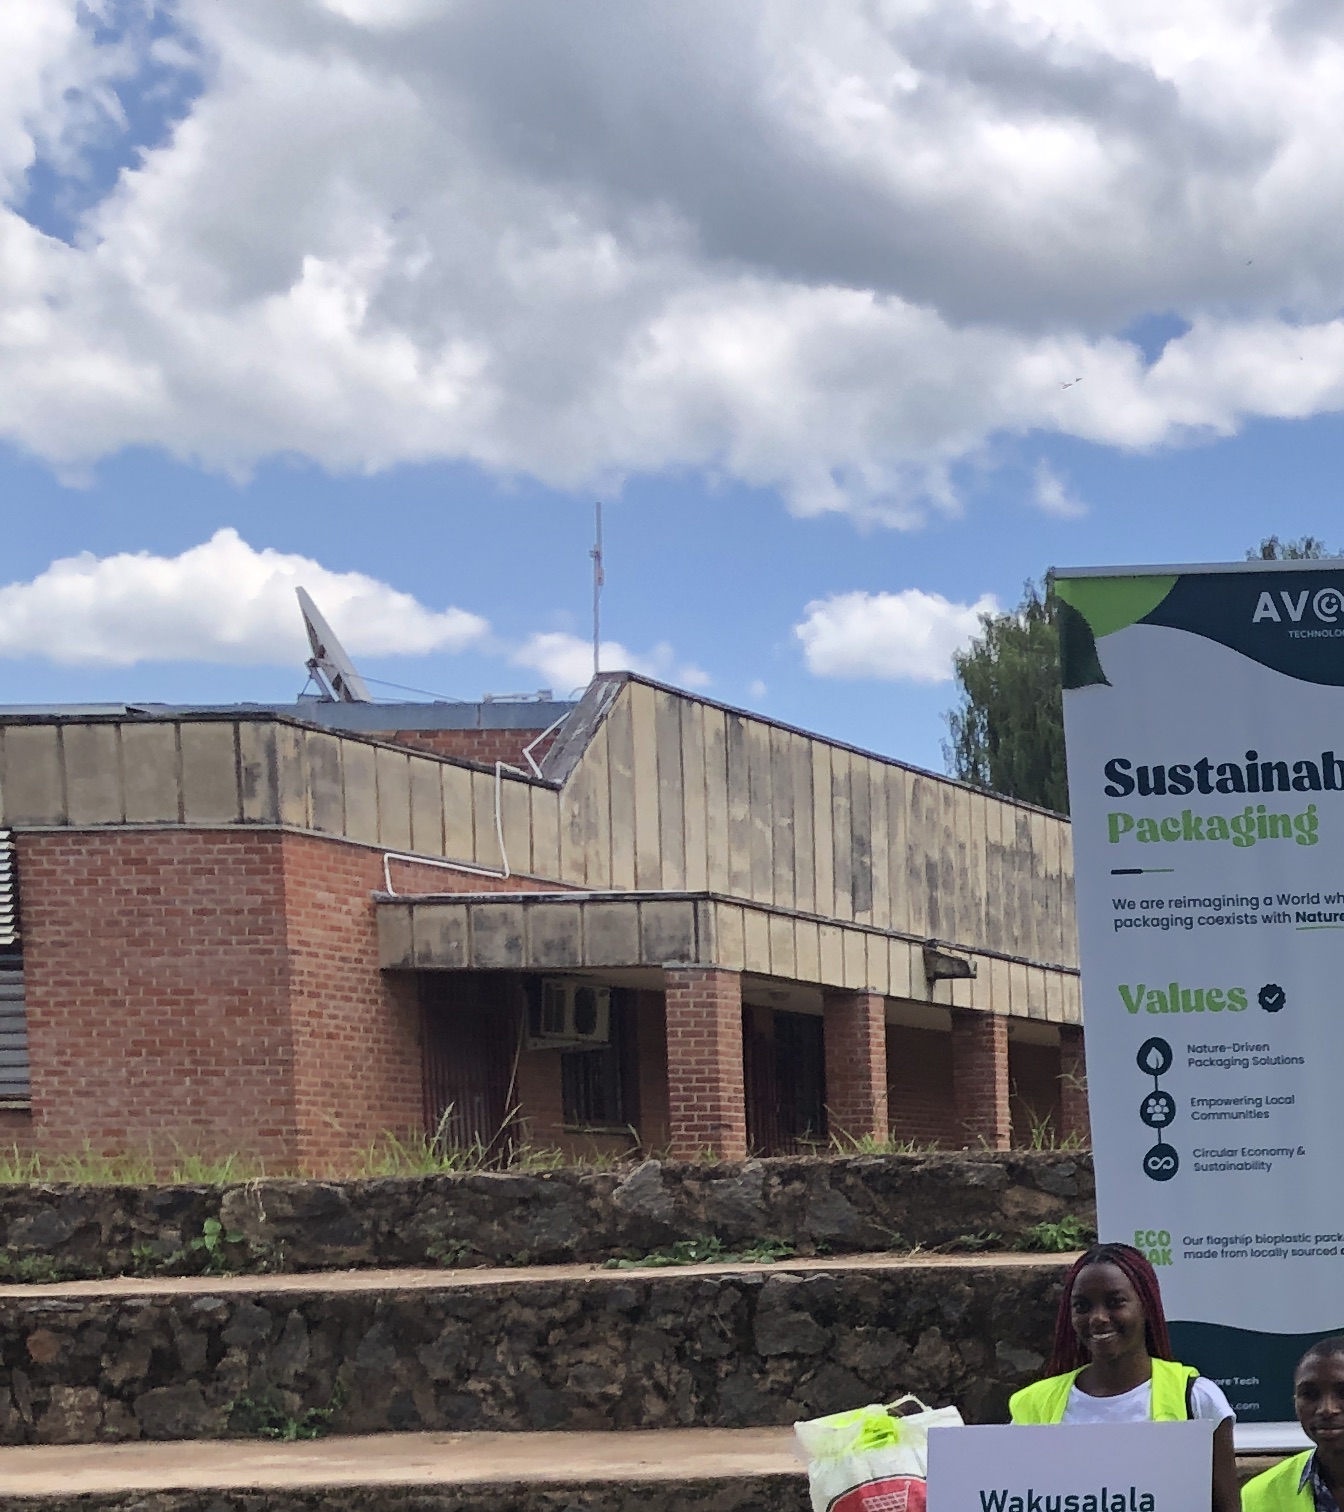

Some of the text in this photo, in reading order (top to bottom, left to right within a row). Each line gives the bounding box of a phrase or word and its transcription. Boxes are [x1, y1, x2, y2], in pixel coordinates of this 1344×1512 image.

[1107, 804, 1319, 847] Packaging
[1112, 898, 1136, 910] We
[1140, 899, 1165, 910] are
[1168, 894, 1260, 911] reimagining
[1263, 896, 1273, 906] a
[1276, 892, 1321, 906] World
[1113, 914, 1194, 932] packaging
[1197, 912, 1258, 926] coexists
[1261, 911, 1292, 924] with
[1118, 982, 1248, 1014] Values
[1187, 1042, 1270, 1053] Nature-Driven
[1188, 1055, 1305, 1070] Packaging Solutions
[1190, 1095, 1296, 1110] Empowering Local
[1191, 1110, 1270, 1121] Communities
[1193, 1146, 1306, 1158] Circular Economy &
[1194, 1161, 1273, 1172] Sustainability
[1134, 1230, 1171, 1248] ECO
[1183, 1236, 1204, 1246] Our
[1206, 1234, 1253, 1248] flagship
[1255, 1233, 1312, 1246] bioplastic
[1146, 1249, 1174, 1266] AK
[1183, 1249, 1218, 1259] made
[1221, 1248, 1248, 1259] from
[1250, 1248, 1289, 1260] locally
[1291, 1246, 1338, 1257] sourced
[1233, 1376, 1260, 1386] Tech
